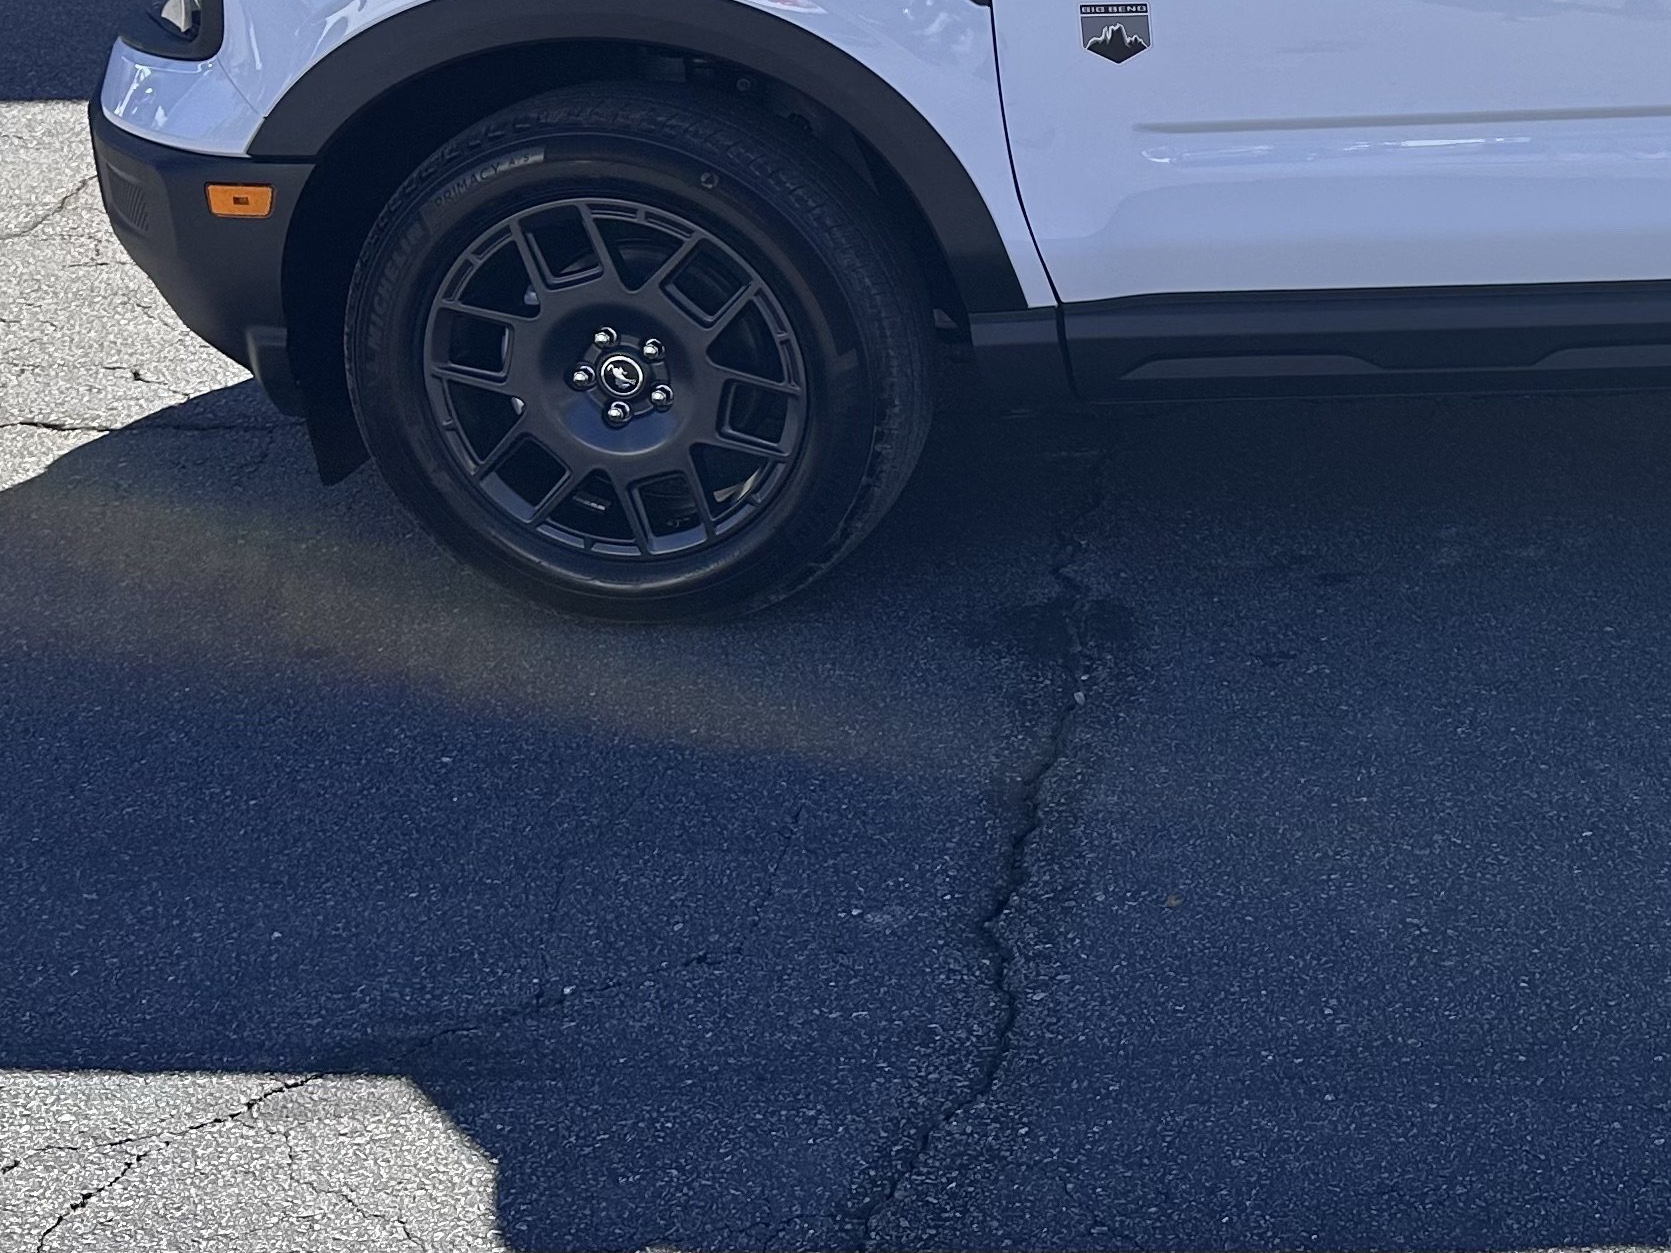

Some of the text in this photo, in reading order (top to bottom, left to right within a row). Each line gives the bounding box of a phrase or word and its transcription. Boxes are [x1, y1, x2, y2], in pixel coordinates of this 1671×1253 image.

[1108, 5, 1147, 13] BEND
[433, 161, 501, 208] PRIMACY
[367, 220, 424, 352] MICHELIN
